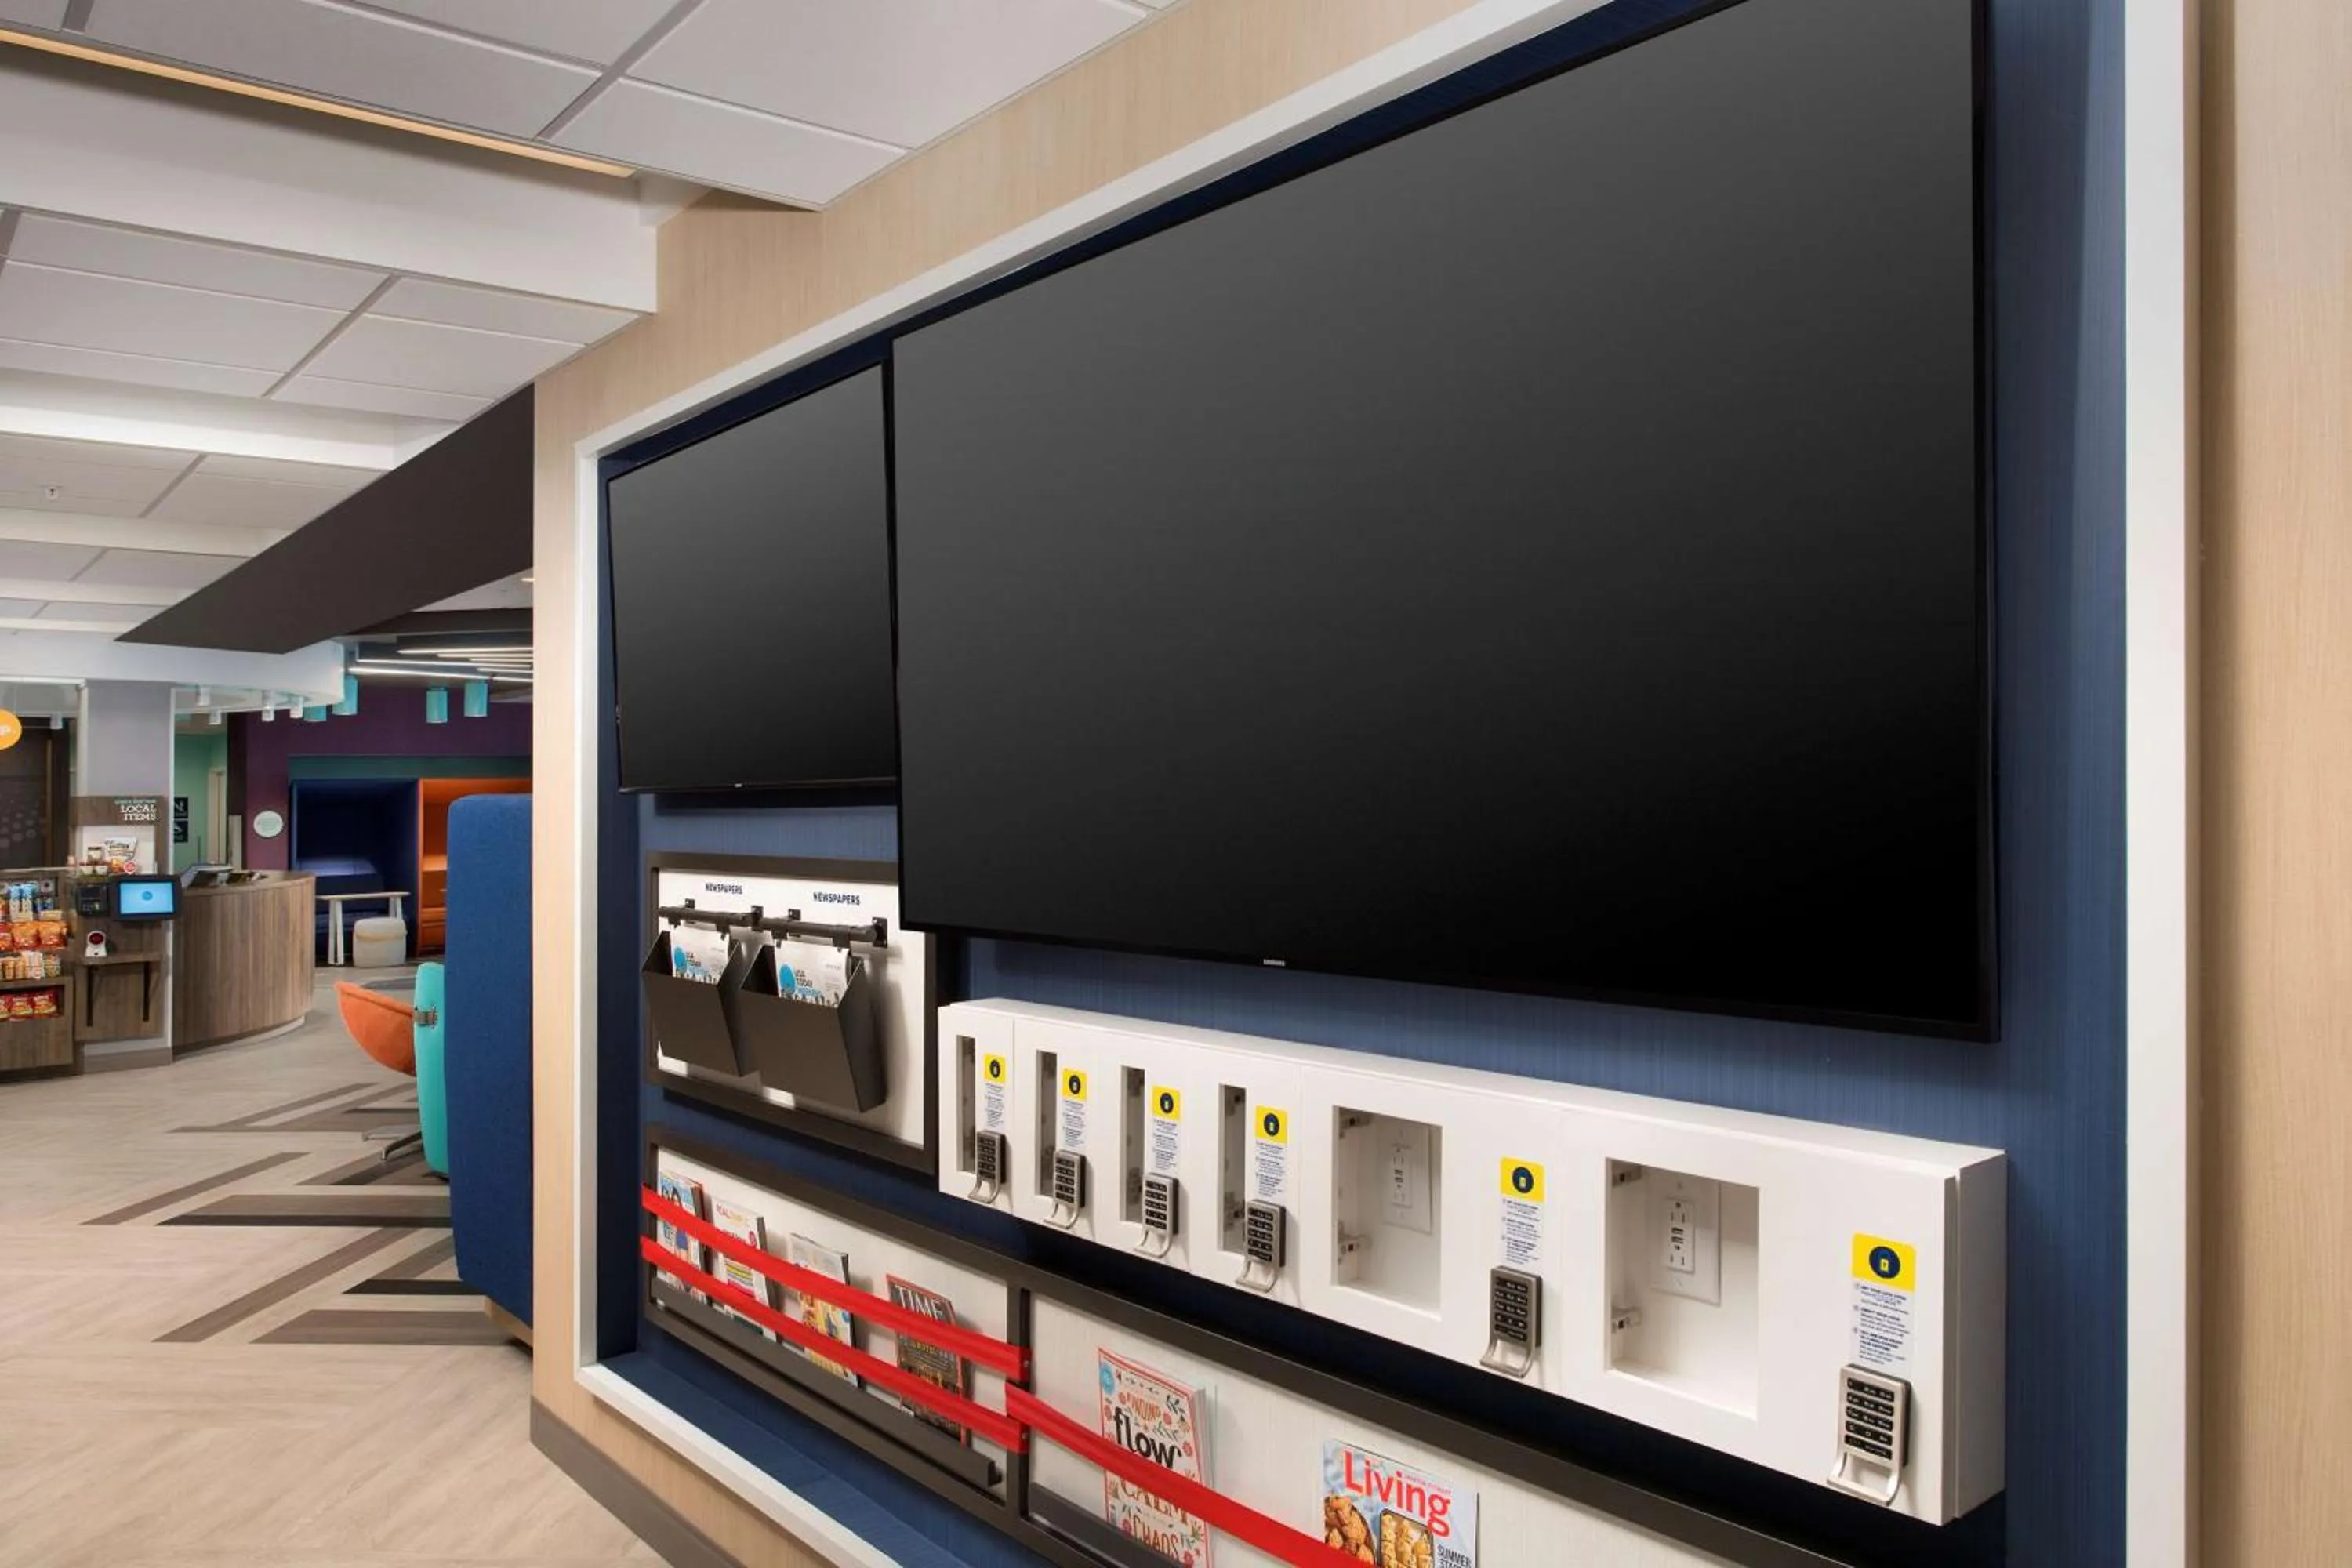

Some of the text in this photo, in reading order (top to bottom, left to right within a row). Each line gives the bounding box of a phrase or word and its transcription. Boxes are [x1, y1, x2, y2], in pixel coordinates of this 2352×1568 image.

[120, 804, 157, 813] LOCAL
[706, 883, 743, 895] NEWSPAPERS
[813, 891, 860, 906] NEWSPAPERS
[894, 1283, 943, 1321] TIME
[1113, 1406, 1182, 1468] flow
[1343, 1450, 1451, 1537] Living
[1437, 1544, 1472, 1568] SUMMER
